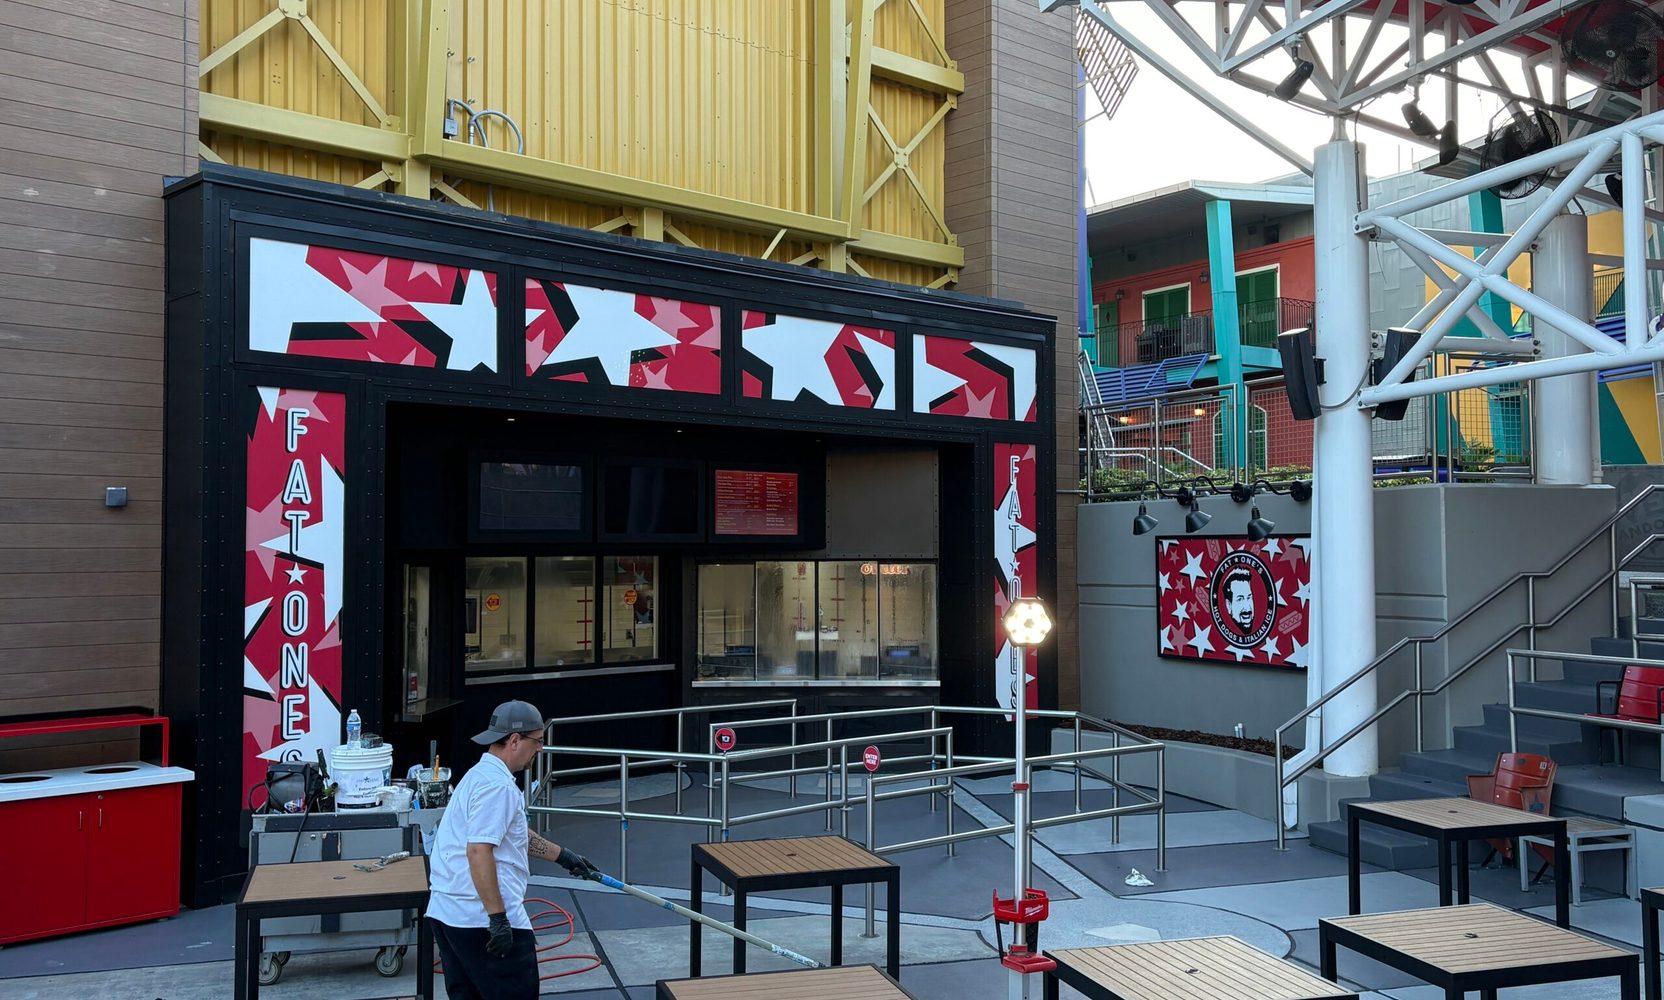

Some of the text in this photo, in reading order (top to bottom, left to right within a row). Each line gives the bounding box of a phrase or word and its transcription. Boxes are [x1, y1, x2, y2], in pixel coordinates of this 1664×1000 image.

[1008, 455, 1022, 554] FAT
[1220, 556, 1263, 574] FAT ONE'S
[281, 407, 312, 763] FAT ONE
[1213, 606, 1223, 623] HOT
[1221, 624, 1237, 641] DOGS
[1245, 624, 1267, 643] ITALIAN
[1264, 608, 1273, 624] ICE
[864, 753, 878, 761] ENTER
